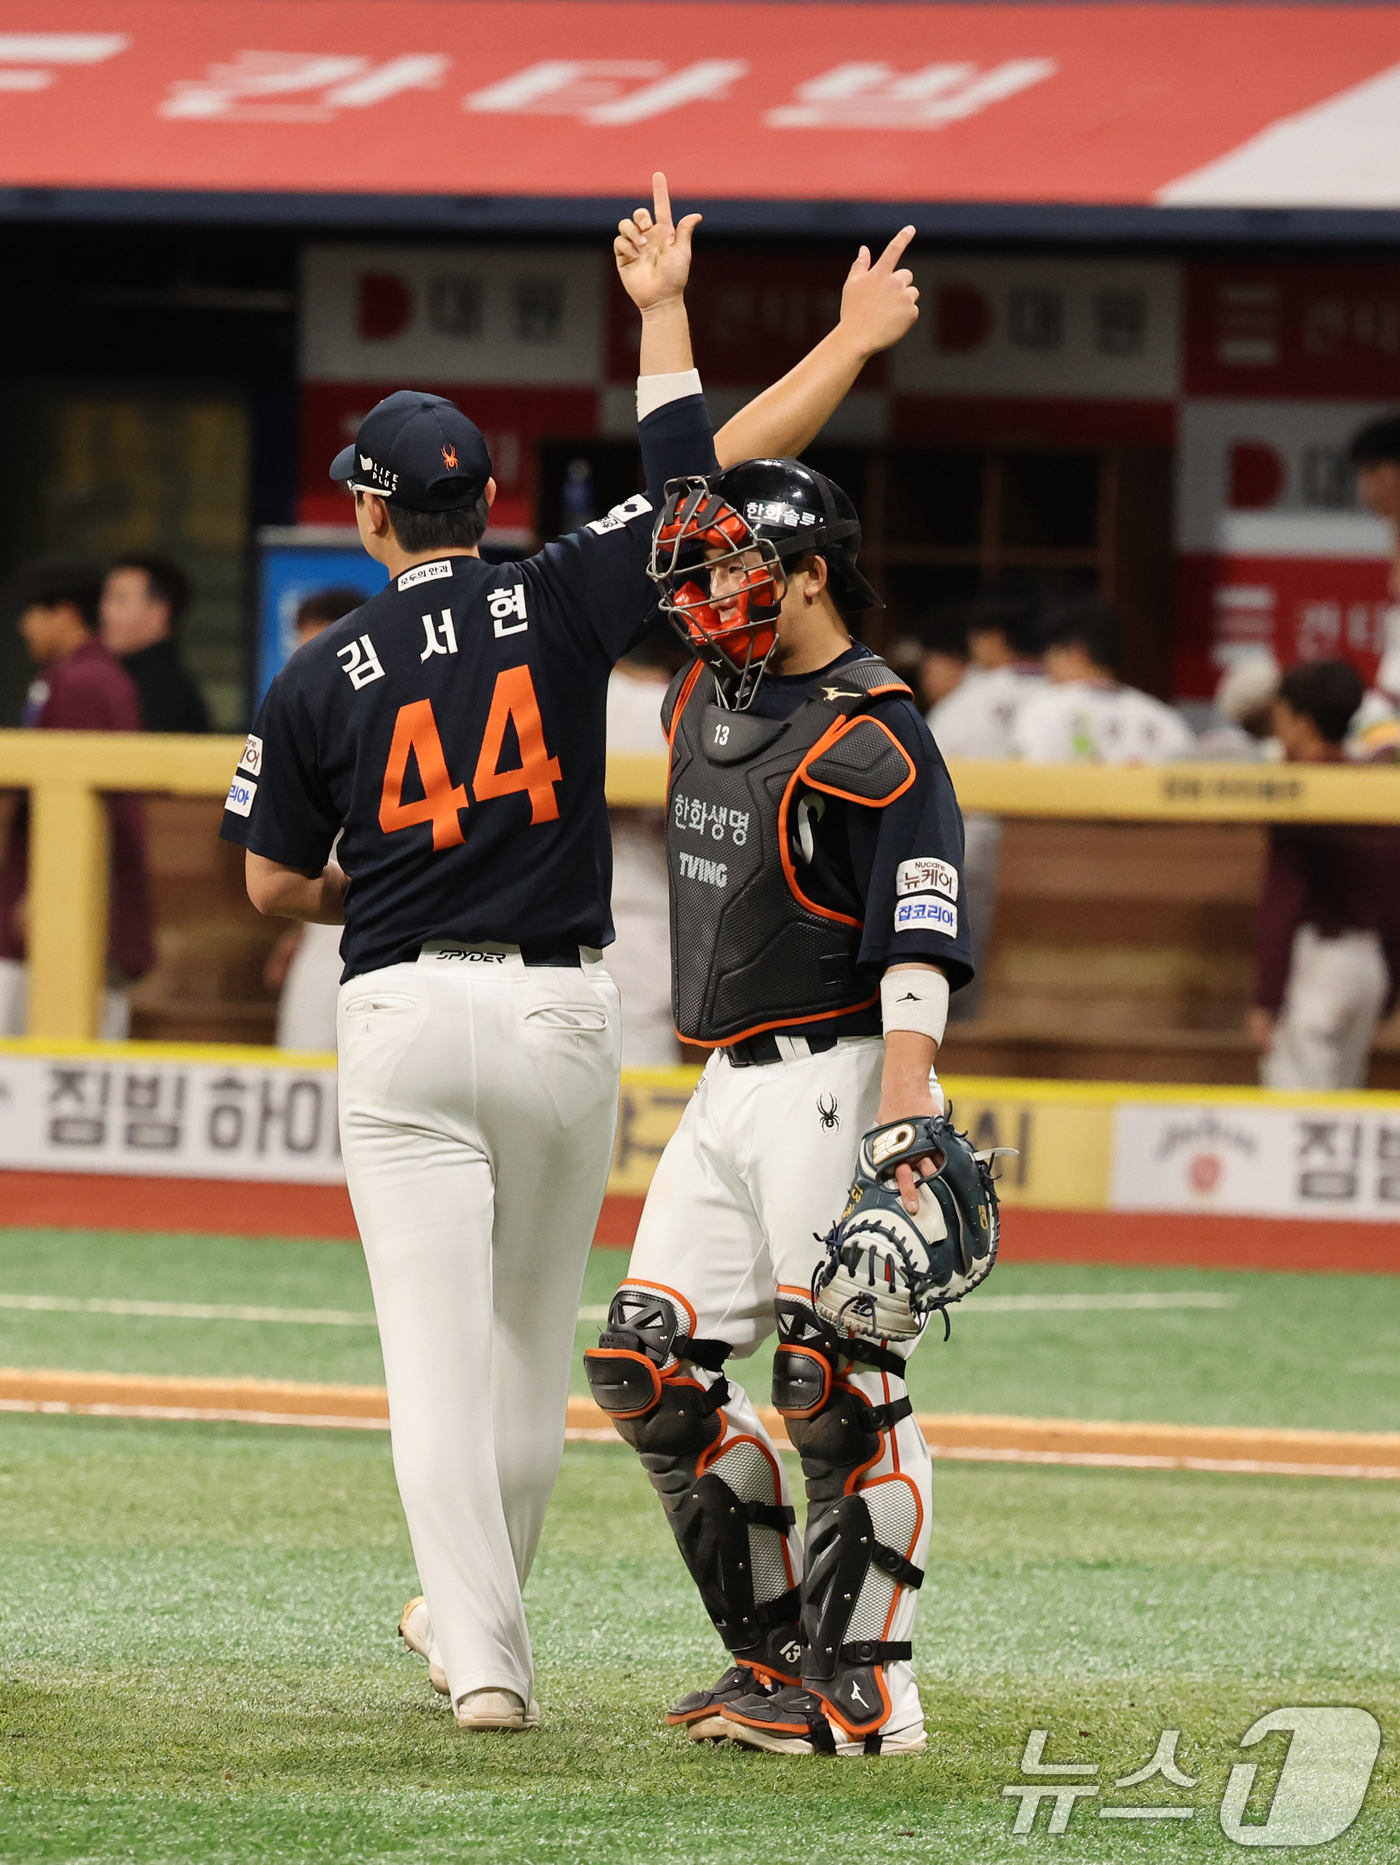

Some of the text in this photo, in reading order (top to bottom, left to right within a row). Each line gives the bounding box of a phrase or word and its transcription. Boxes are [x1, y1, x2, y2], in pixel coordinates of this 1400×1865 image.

[371, 471, 397, 492] PLUS
[372, 463, 399, 484] LIFE
[746, 501, 824, 528] 한화솔루
[400, 564, 449, 587] 모두의 안과
[336, 584, 529, 692] 김서현
[714, 723, 730, 746] 13
[378, 663, 564, 852] 44
[674, 793, 751, 846] 한화생명
[679, 851, 728, 888] TVING
[914, 861, 946, 872] Nucare
[904, 869, 953, 894] 뉴케어
[898, 904, 955, 927] 잡코리아
[436, 949, 507, 964] SPYDER
[779, 1639, 801, 1663] 13
